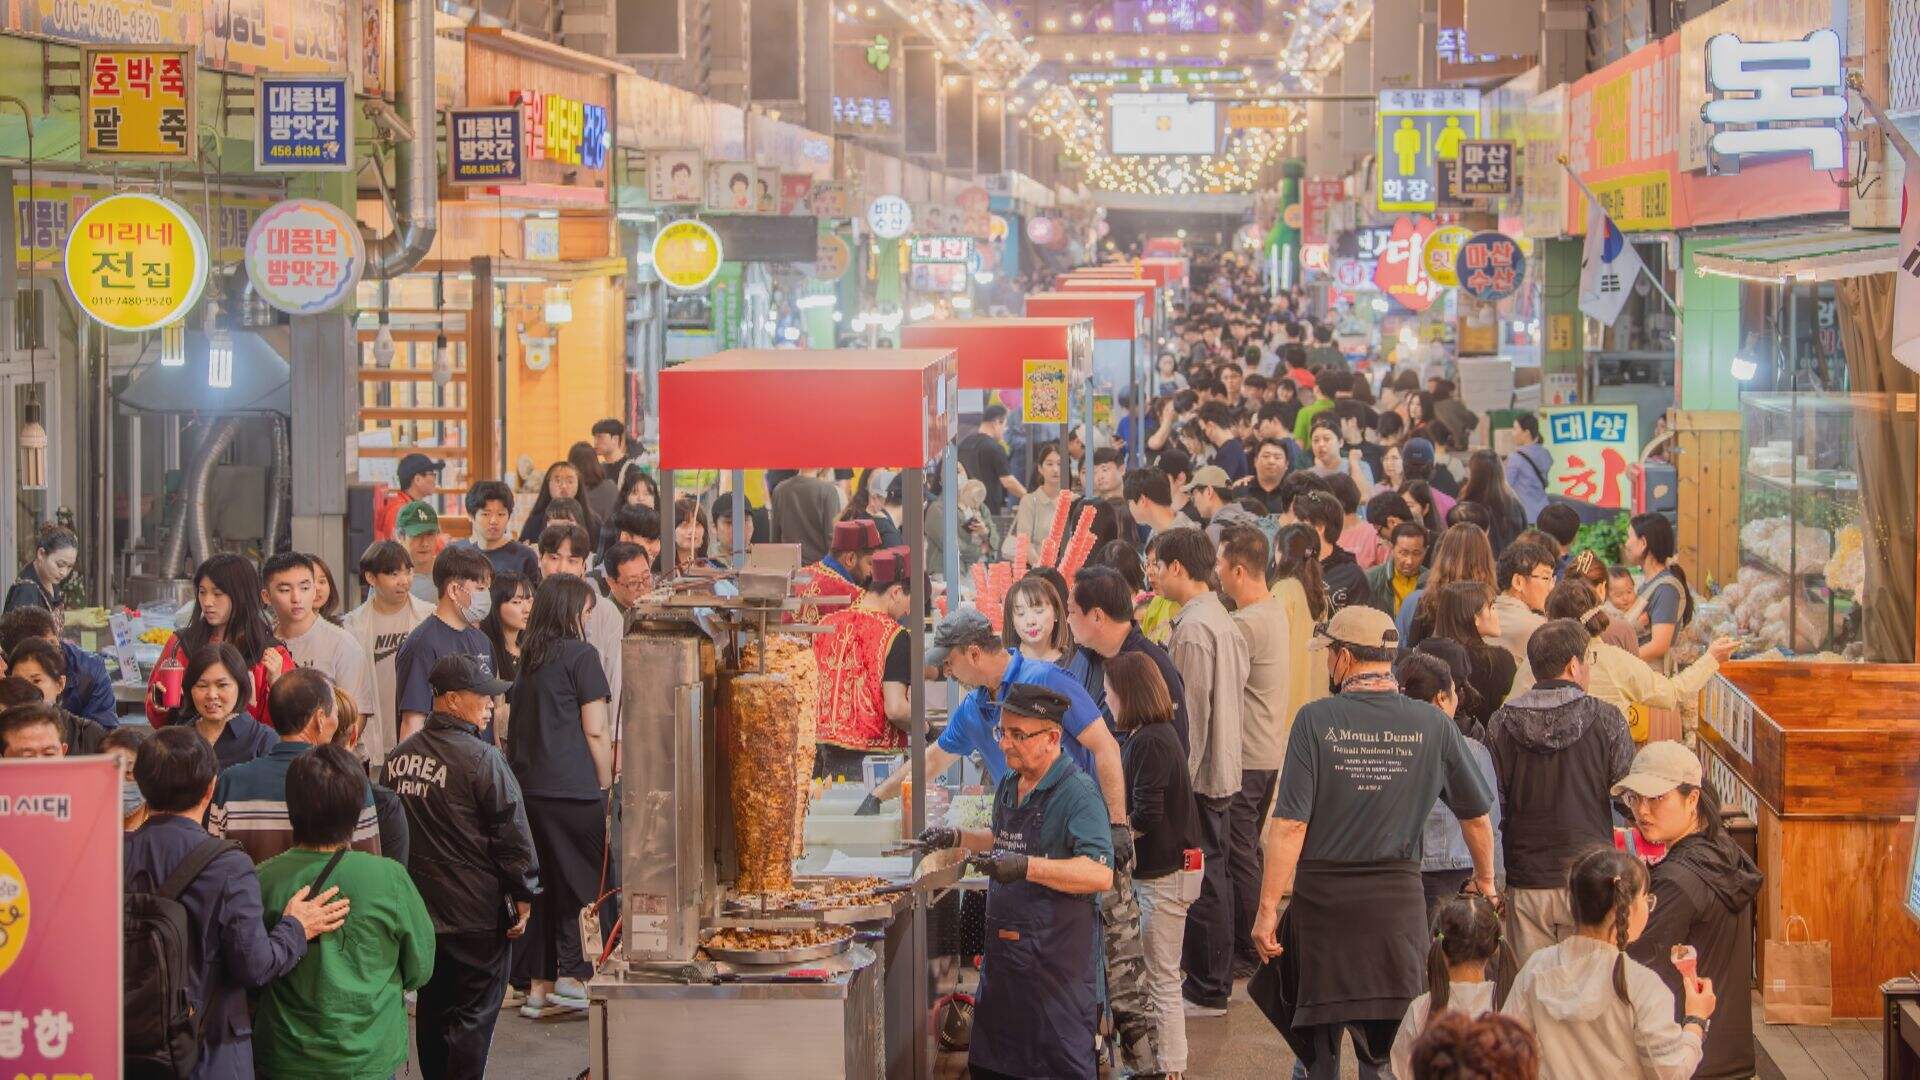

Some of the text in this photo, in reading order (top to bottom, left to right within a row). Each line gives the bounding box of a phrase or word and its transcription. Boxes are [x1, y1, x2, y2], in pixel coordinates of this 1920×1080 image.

[269, 86, 336, 112] 대풍년
[270, 115, 339, 140] 방앗간
[458, 117, 512, 139] 대풍년
[459, 138, 514, 161] 방앗간
[1464, 145, 1508, 164] 마산
[1464, 165, 1508, 182] 수산
[1383, 179, 1436, 201] 화장
[88, 222, 173, 246] 미리네
[267, 228, 337, 255] 대풍년
[1466, 242, 1514, 268] 마산
[267, 260, 339, 287] 방앗간
[1467, 268, 1515, 293] 수산
[91, 296, 173, 306] 010-7480-9520
[1340, 729, 1379, 742] Mount
[1360, 747, 1393, 755] National
[1395, 747, 1413, 756] Park
[387, 754, 447, 788] KOREA
[16, 797, 70, 819] 시대
